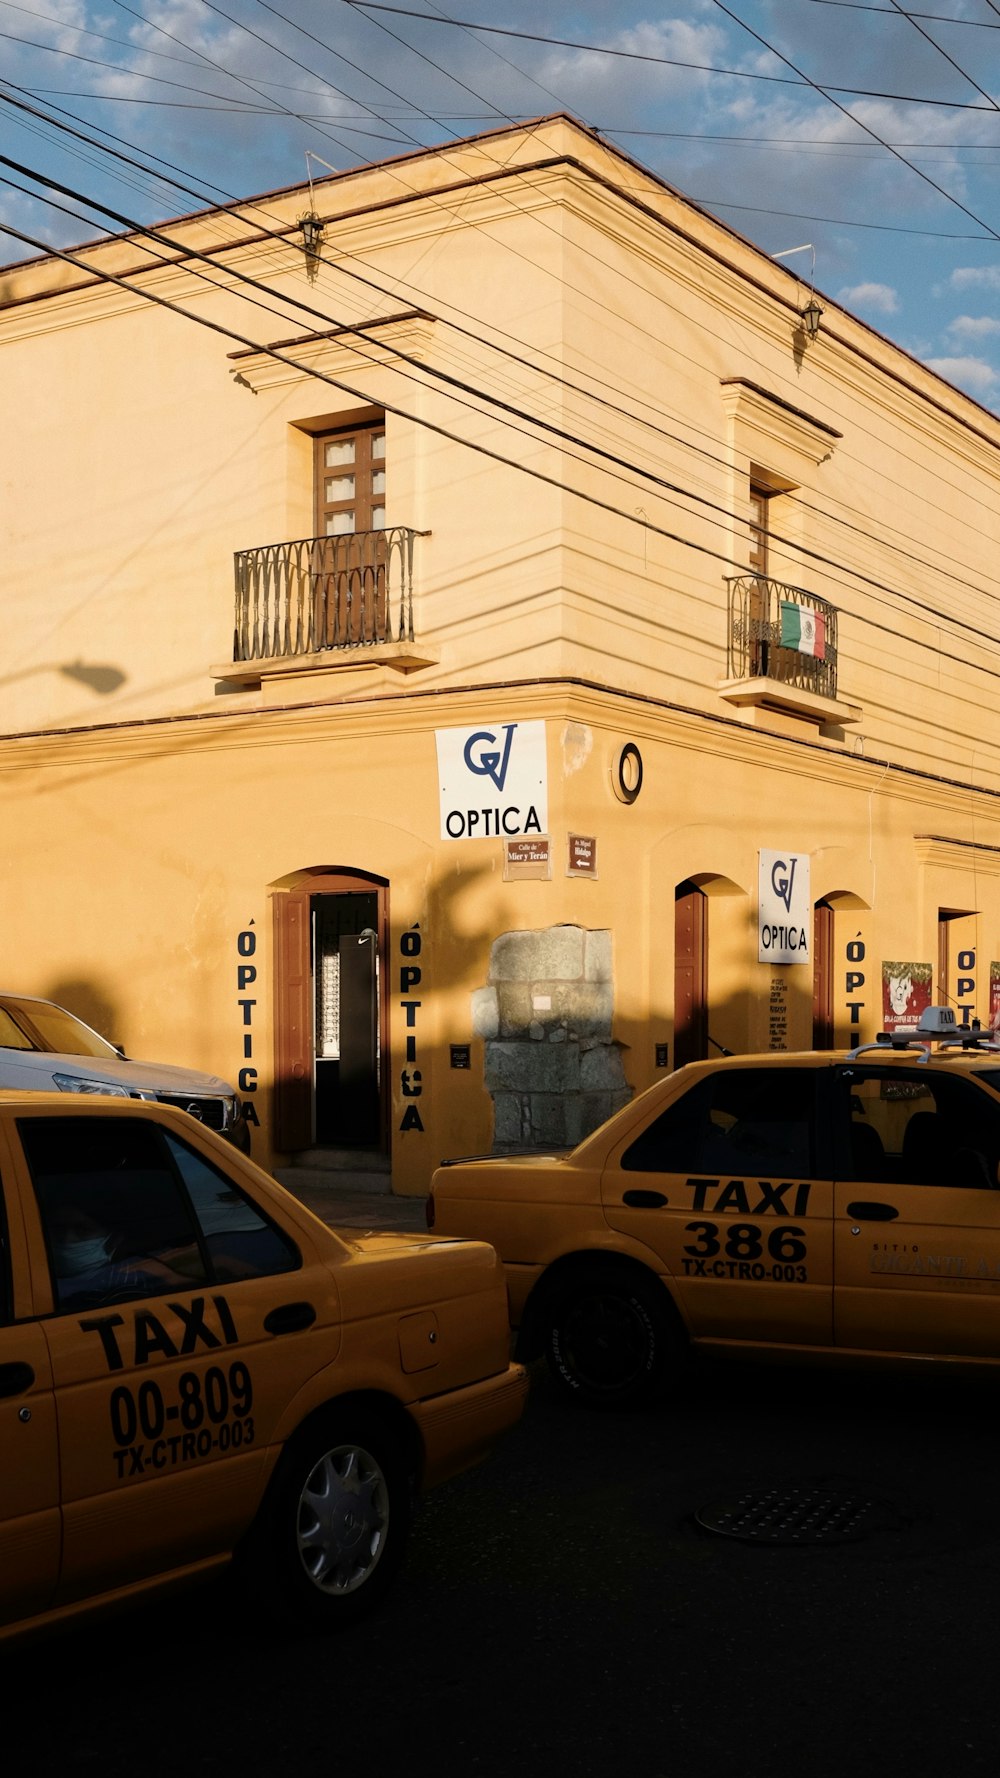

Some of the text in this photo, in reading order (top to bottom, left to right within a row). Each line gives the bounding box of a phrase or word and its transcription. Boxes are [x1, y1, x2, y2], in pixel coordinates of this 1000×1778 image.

[446, 806, 542, 838] OPTICA
[508, 852, 524, 861] Mier
[530, 851, 548, 860] Terán
[531, 843, 537, 851] de
[574, 847, 592, 857] Hidalgo
[761, 924, 807, 951] OPTICA
[846, 930, 866, 1050] ÓPTI
[237, 918, 261, 1127] ÓPTICA
[399, 922, 425, 1132] ÓPTICA
[940, 1010, 954, 1024] TAXI
[685, 1178, 811, 1217] TAXI
[683, 1221, 807, 1263] 386
[873, 1243, 919, 1253] SITIO
[681, 1258, 808, 1283] TX-CTRO-003
[77, 1295, 239, 1372] TAXI
[109, 1361, 253, 1447] 00-809
[112, 1417, 255, 1479] TX-CTRO-003
